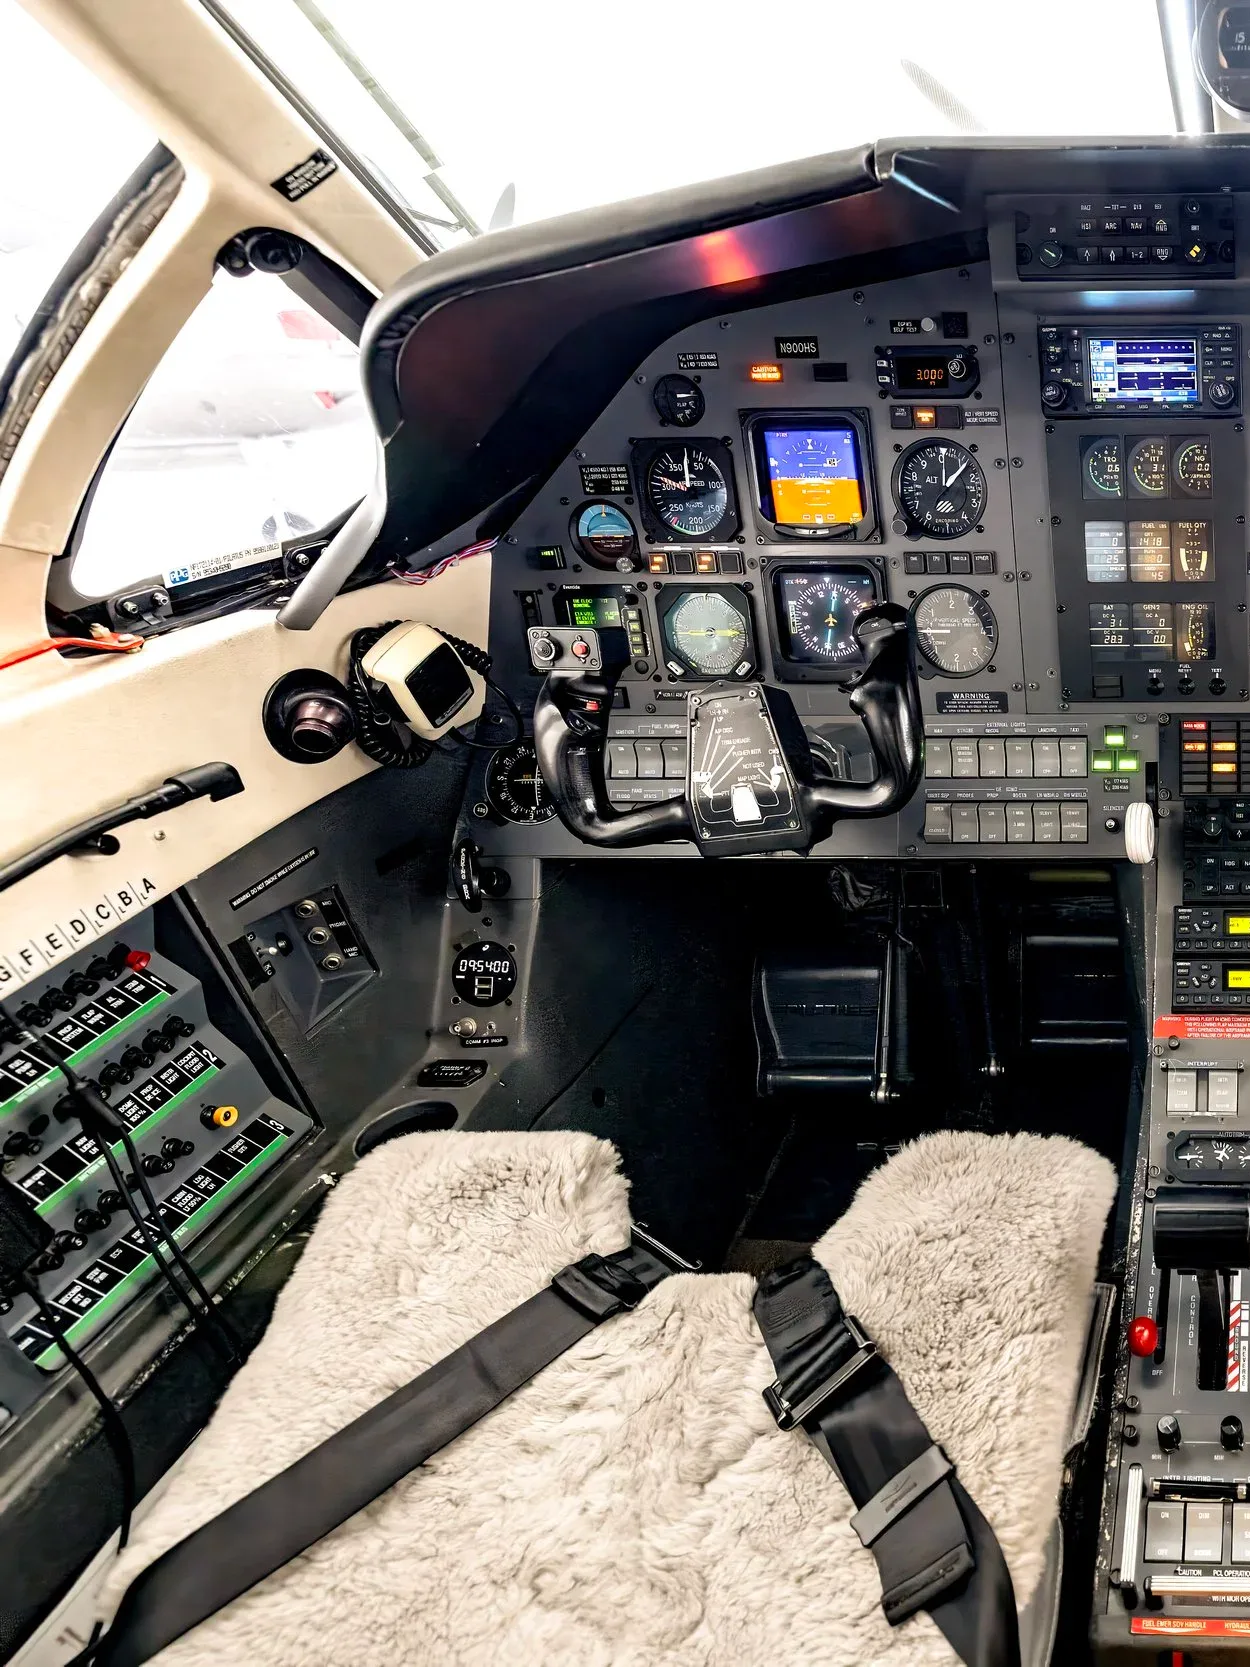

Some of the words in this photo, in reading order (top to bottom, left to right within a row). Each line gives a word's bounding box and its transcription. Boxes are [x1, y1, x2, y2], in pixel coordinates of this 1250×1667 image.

[780, 342, 817, 353] N900HS
[669, 464, 683, 472] 350
[921, 461, 927, 470] 9
[1108, 464, 1120, 472] 0.6
[1197, 464, 1210, 472] 0.0
[912, 472, 918, 481] 8
[926, 476, 939, 484] ALT
[970, 474, 976, 482] 2
[709, 481, 721, 489] 100
[669, 504, 684, 512] 250
[708, 504, 720, 512] 150
[926, 512, 932, 521] 6
[1139, 538, 1162, 546] 1418
[1152, 572, 1164, 581] 45
[1104, 635, 1123, 644] 28.3
[1154, 635, 1166, 644] 0.0
[143, 878, 157, 894] A
[117, 891, 133, 907] B
[96, 904, 110, 920] C
[70, 920, 86, 935] D
[45, 933, 63, 950] E
[19, 949, 33, 966] F
[460, 959, 509, 973] 09:54:00
[0, 966, 12, 982] G
[150, 976, 167, 987] 1
[57, 1024, 73, 1037] PROP
[62, 1027, 85, 1043] SYSTEM
[202, 1049, 218, 1062] 2
[191, 1062, 204, 1074] LIGHT
[166, 1072, 180, 1085] LIGHT
[140, 1084, 154, 1096] PROP
[118, 1100, 135, 1113] DOME
[125, 1105, 140, 1118] LIGHT
[270, 1120, 285, 1131] 3
[79, 1139, 96, 1153] LIGHT
[198, 1177, 213, 1189] LIGHT
[179, 1193, 194, 1208] FLOOD
[1188, 1295, 1196, 1346] CONTROL
